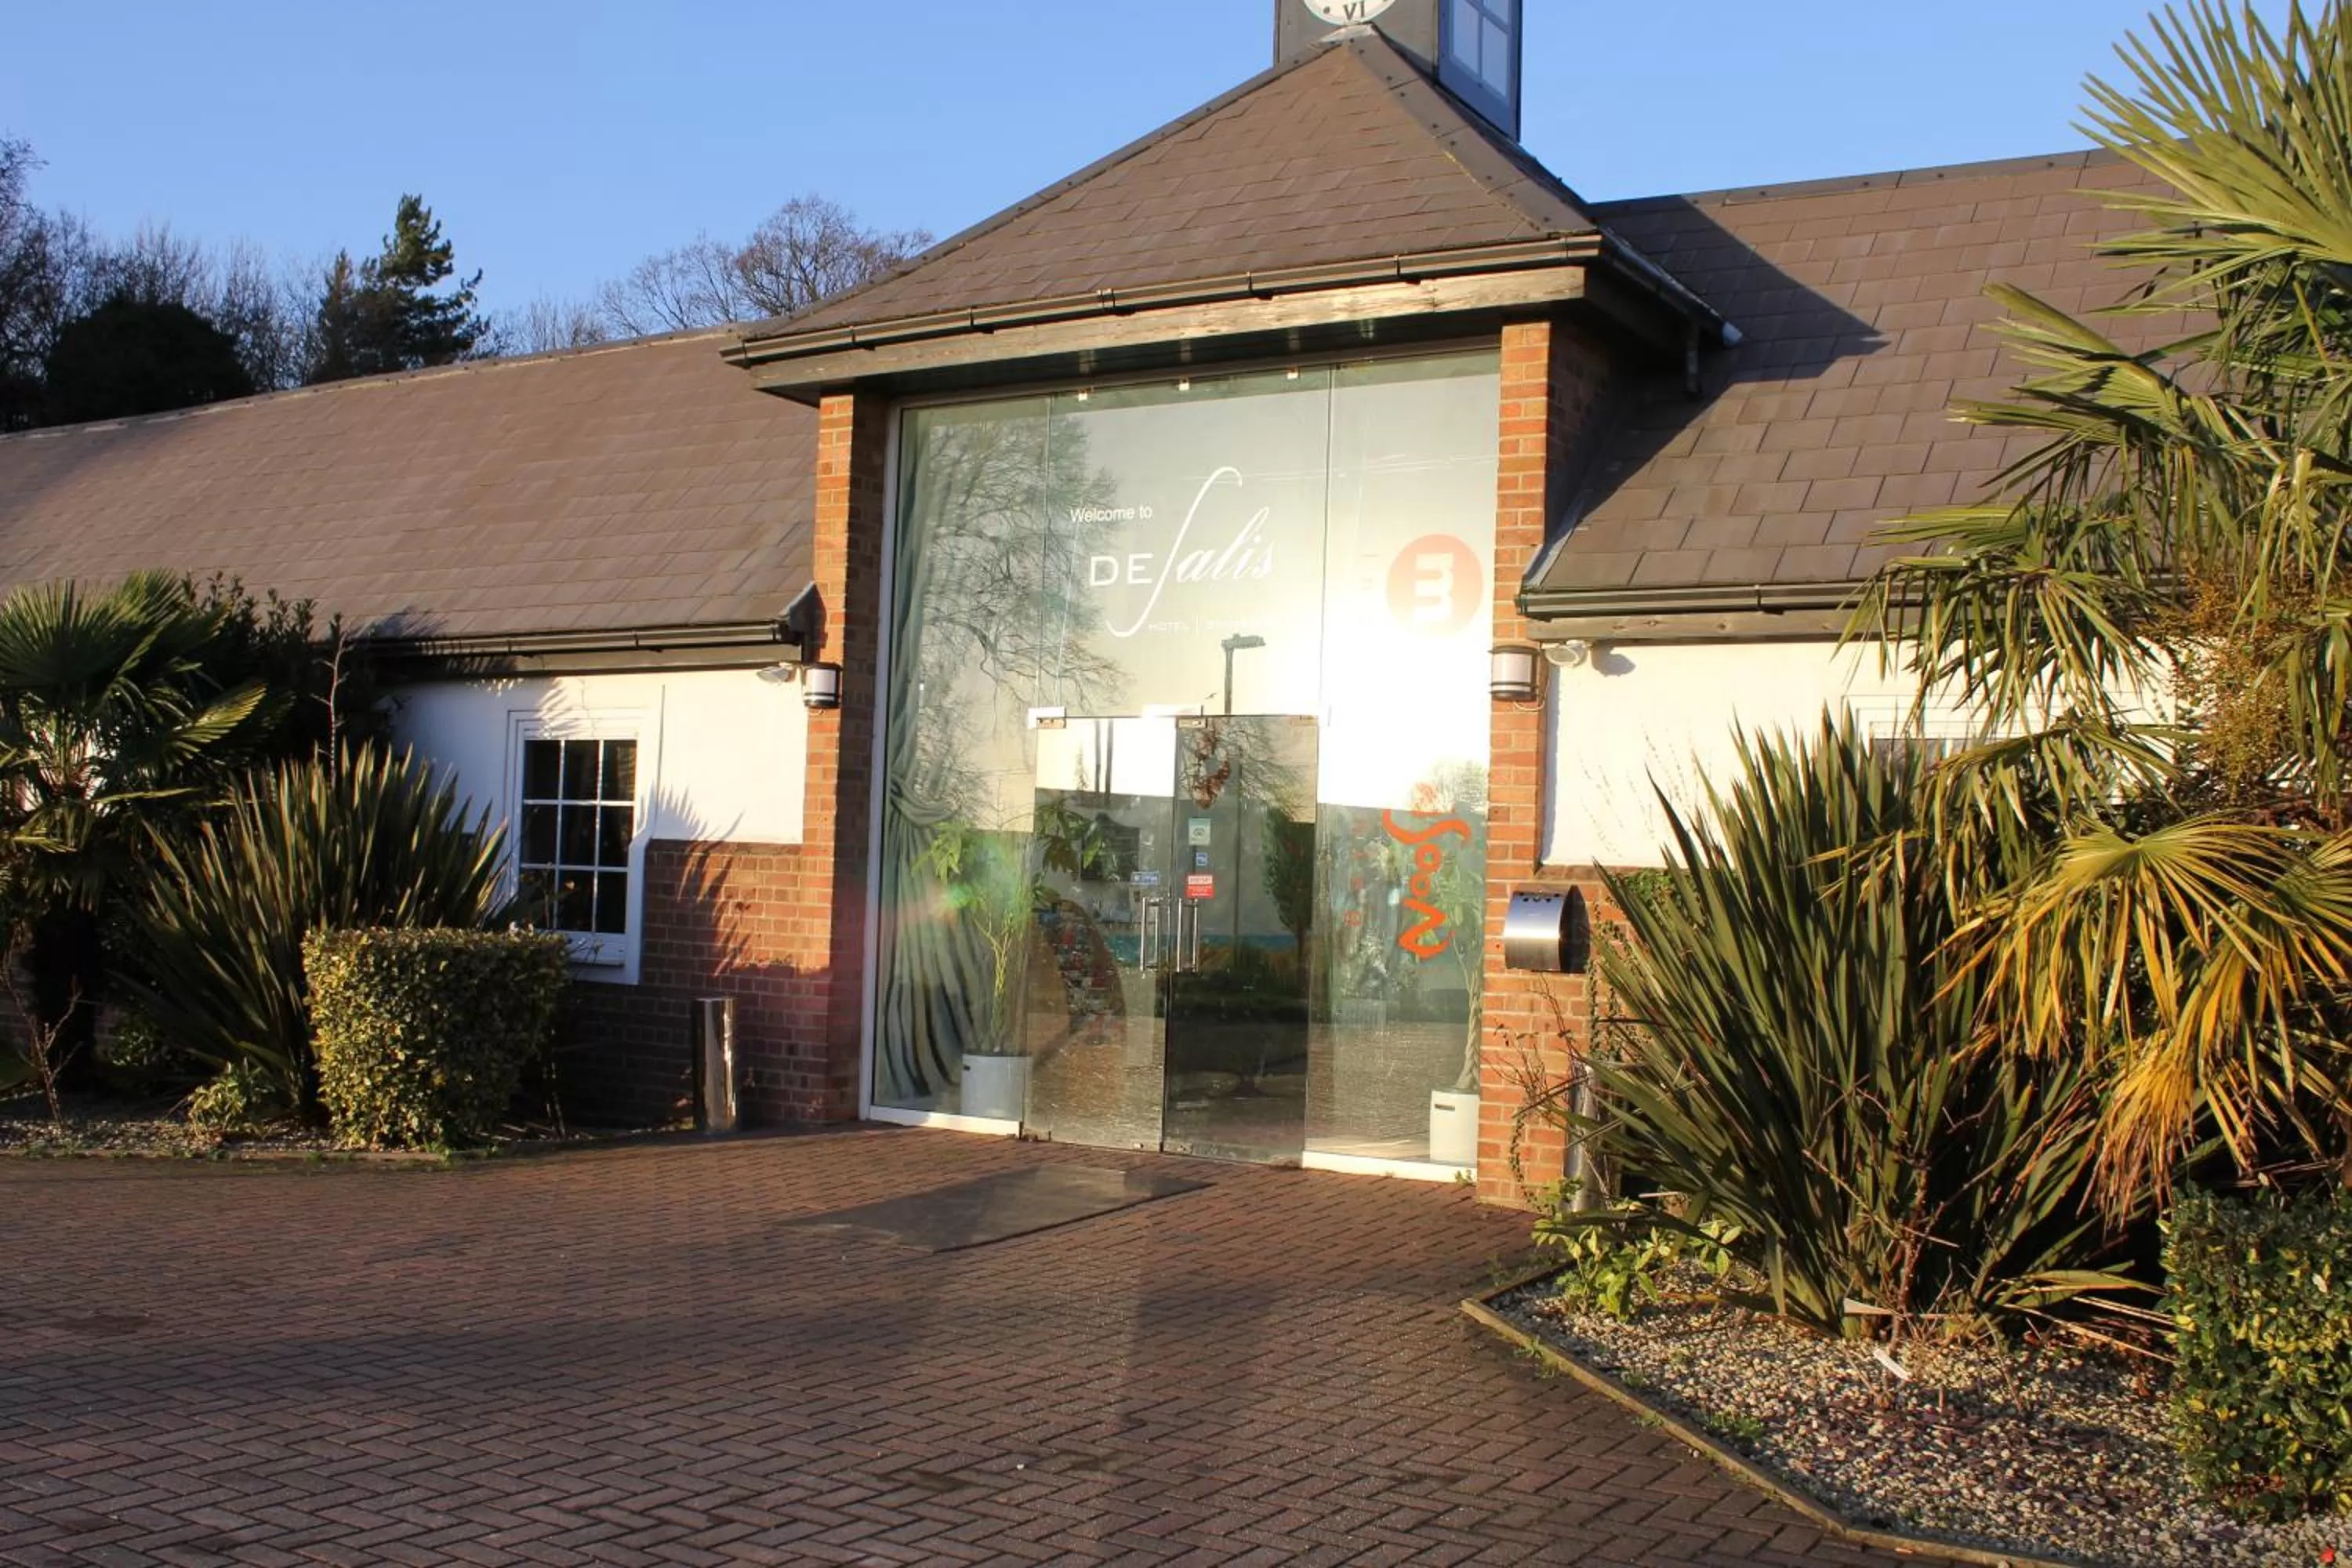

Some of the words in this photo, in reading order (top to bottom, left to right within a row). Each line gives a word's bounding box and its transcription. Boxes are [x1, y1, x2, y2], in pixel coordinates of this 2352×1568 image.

[1342, 1, 1364, 20] VI
[1069, 507, 1135, 523] Welcome
[1139, 505, 1153, 519] to
[1089, 553, 1154, 586] DE
